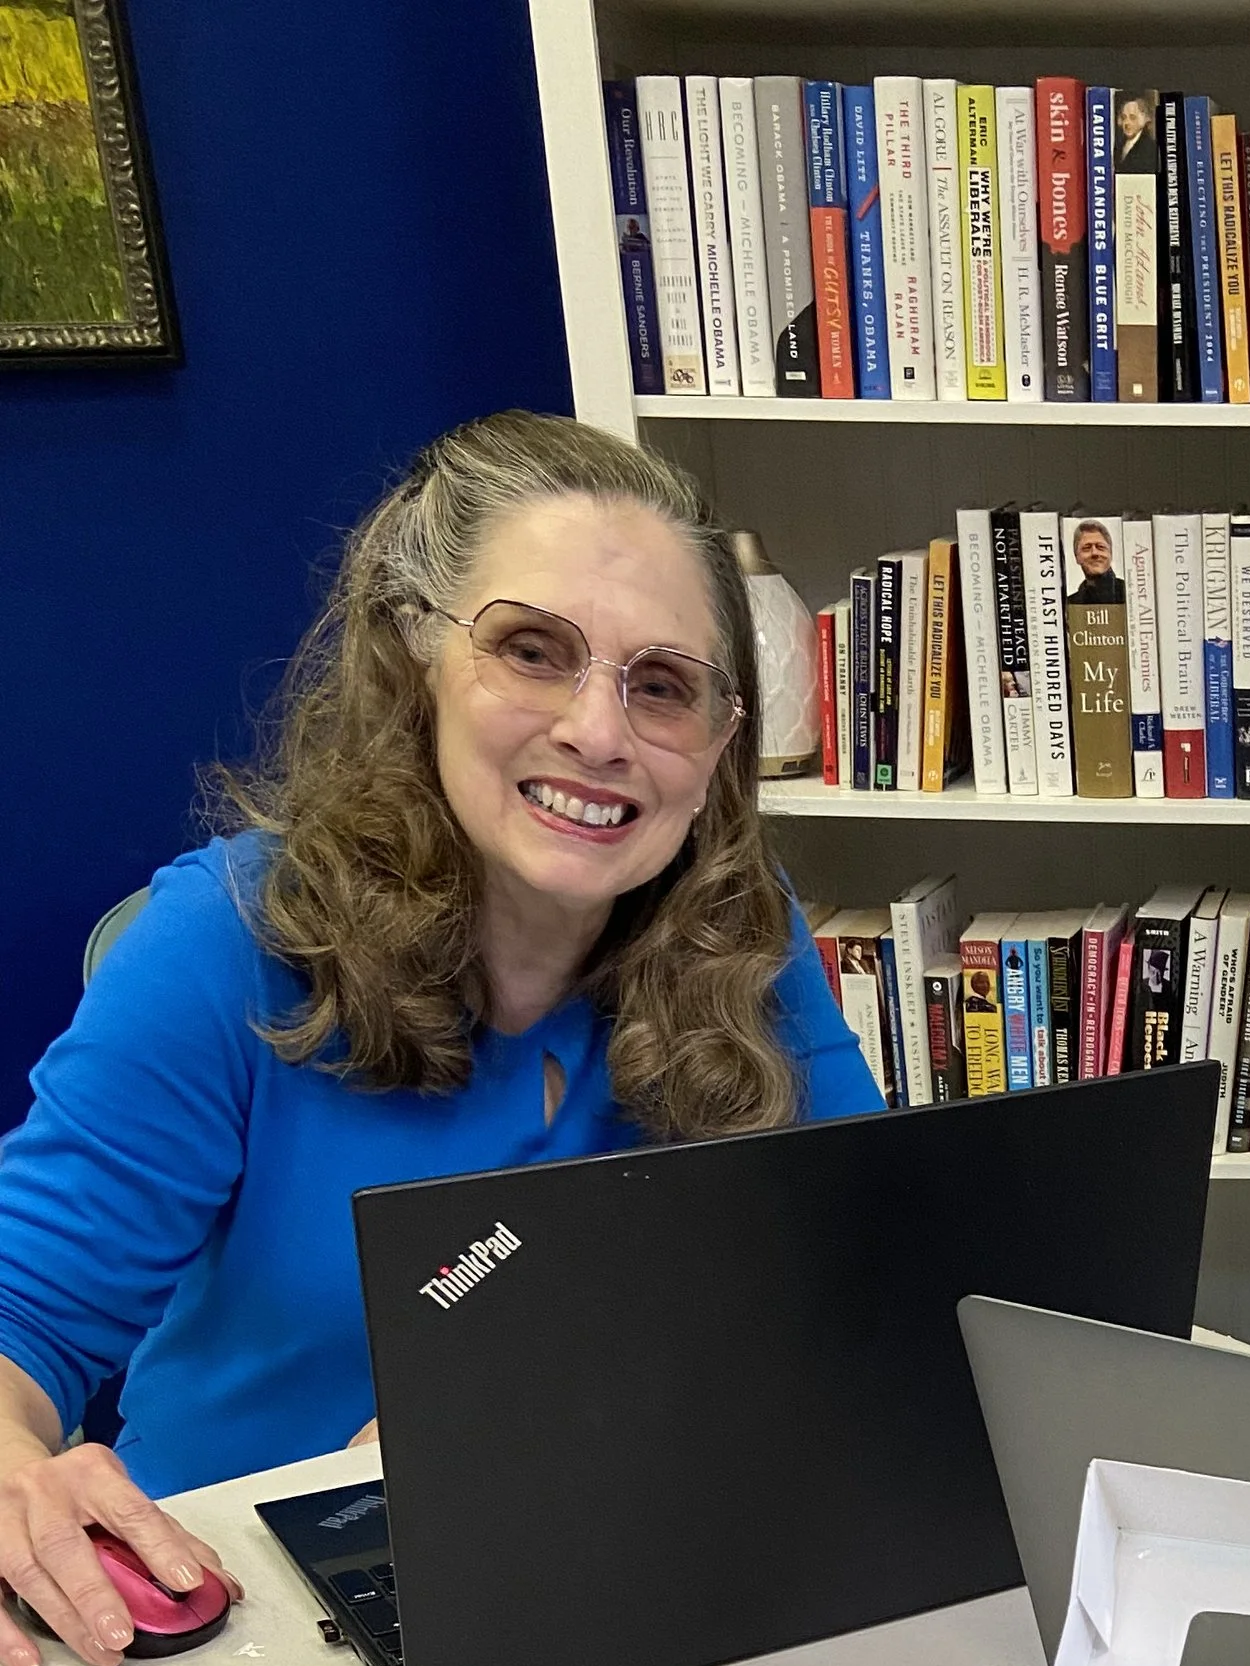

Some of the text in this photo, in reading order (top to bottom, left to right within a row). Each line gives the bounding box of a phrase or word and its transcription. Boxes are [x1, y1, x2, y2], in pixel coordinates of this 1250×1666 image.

[621, 108, 638, 206] Our Revolution
[854, 105, 866, 182] DAVID LITT
[884, 113, 896, 167] PILLAR
[899, 101, 912, 179] THE THIRD
[968, 97, 978, 165] ALTERMAN
[979, 117, 988, 147] ERIC
[1220, 151, 1233, 172] LET
[696, 88, 725, 369] THE LIGHT WE CARRY MICHELLE OBAMA
[933, 92, 955, 361] AL GORE The ASSAULT ON REASON
[969, 170, 982, 258] LIBERALS
[980, 170, 992, 258] WHY WE'RE
[1092, 104, 1108, 350] LAURA FLANDERS BLUE GRIT
[1222, 176, 1234, 203] THIS
[732, 102, 761, 365] BECOMING MICHELLE OBAMA
[772, 104, 798, 359] BARACK OBAMA A PROMISED LAND
[1224, 205, 1238, 271] RADICALIZE
[632, 260, 650, 358] BERNIE SANDERS
[860, 231, 877, 372] THANKS, OBAMA
[894, 293, 905, 339] RAJAN
[907, 276, 921, 356] RAGHURAM
[1227, 275, 1240, 296] YOU
[881, 566, 893, 644] RADICAL HOPE
[994, 528, 1014, 666] NOT APARTHEID
[1175, 528, 1192, 696] The Political Brain
[1205, 526, 1228, 630] KRUGMAN
[1241, 566, 1250, 584] WE
[930, 574, 945, 699] LET THIS RADICALIZE YOU
[968, 533, 993, 767] BECOMING MICHELLE OBAMA
[1038, 535, 1065, 760] JFK'S LAST HUNDRED DAYS
[1073, 631, 1125, 646] Clinton
[1086, 609, 1109, 626] Bill
[1131, 543, 1156, 693] Against All Enemies
[1080, 690, 1124, 713] Life
[1083, 661, 1119, 689] My
[859, 692, 868, 747] JOHN LEWIS
[1007, 704, 1020, 752] CARTER
[1019, 708, 1033, 749] JIMMY
[962, 955, 997, 966] MANDELA
[965, 945, 993, 955] NELSON
[1186, 931, 1208, 1016] A Warning
[1226, 948, 1239, 1024] WHO'S AFRAID
[899, 914, 924, 1089] STEVE INSKEEP INSTANT
[1006, 968, 1029, 1084] ANGRY WHITE MEN
[1032, 947, 1048, 1080] So you want to talk about
[1155, 1011, 1170, 1062] Black
[1219, 1062, 1229, 1099] JUDITH
[418, 1221, 522, 1310] ThinkPad
